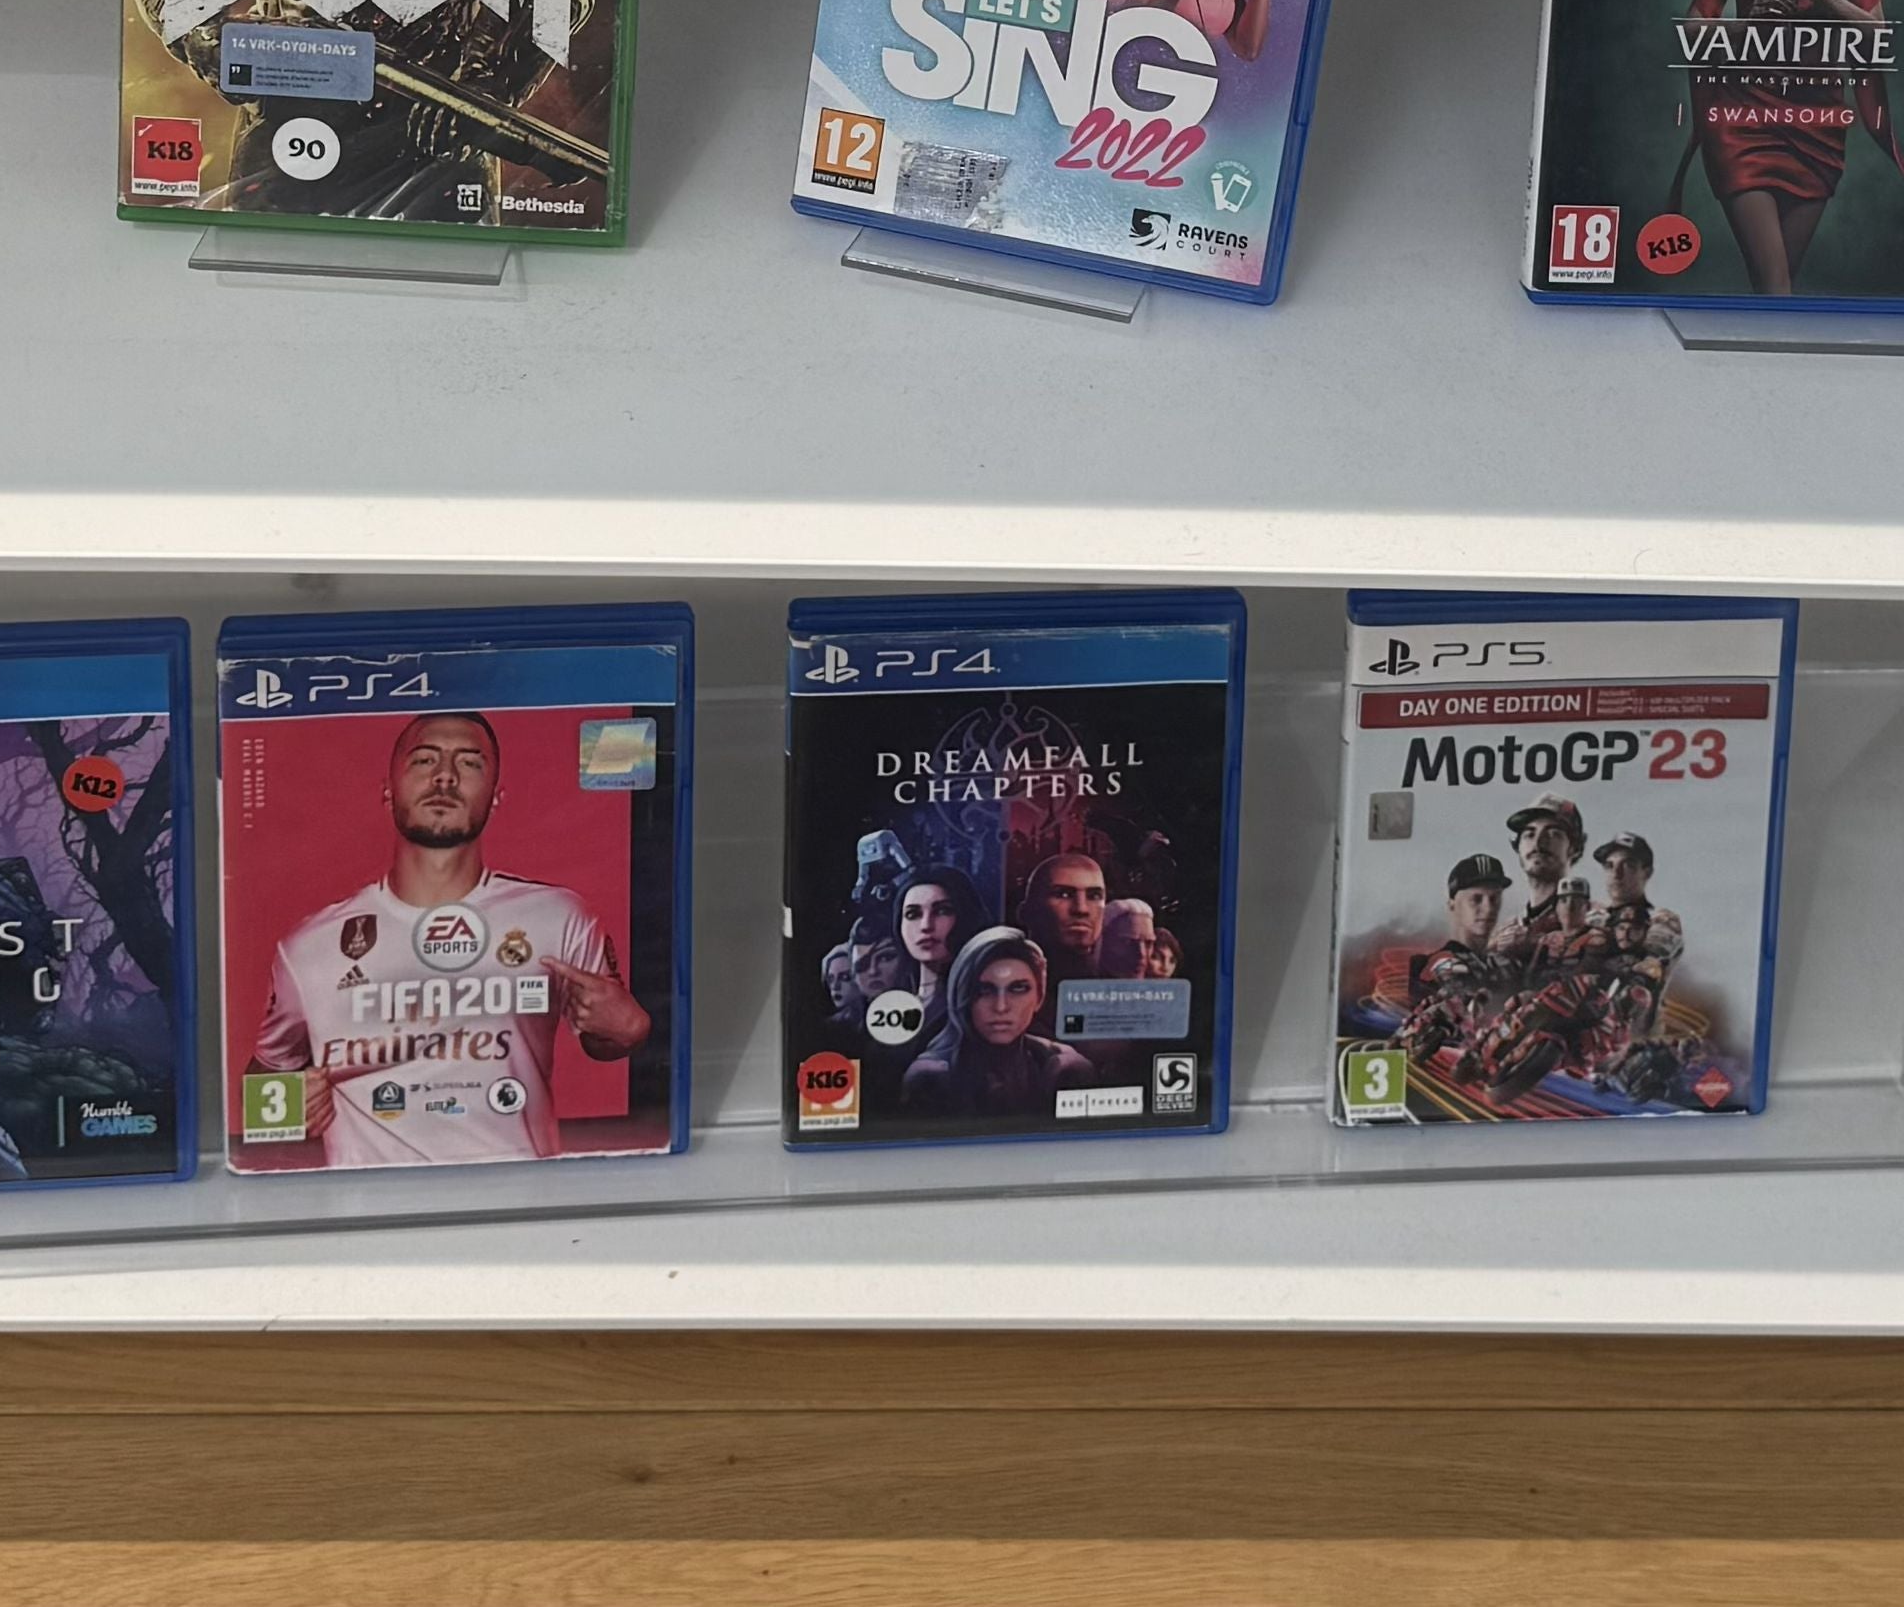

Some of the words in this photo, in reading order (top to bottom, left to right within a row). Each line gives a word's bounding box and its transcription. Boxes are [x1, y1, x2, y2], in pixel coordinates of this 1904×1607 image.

[1675, 24, 1896, 64] VAMPIRE
[1696, 74, 1728, 85] THE
[1740, 75, 1870, 92] MASQUERADE
[1708, 106, 1856, 125] SWANSONG
[147, 141, 194, 161] K18
[288, 138, 326, 160] 90
[824, 118, 876, 171] 12
[1054, 107, 1207, 187] 2022
[501, 196, 585, 215] Bethesda
[1178, 223, 1248, 249] RAVENS
[1558, 213, 1612, 262] 18
[1647, 233, 1693, 259] K18
[1176, 240, 1246, 261] COURT
[876, 648, 996, 678] PS4
[1433, 641, 1547, 667] PS5
[309, 672, 433, 702] PS4
[1400, 699, 1440, 717] DAY
[1445, 697, 1487, 715] ONE
[1493, 694, 1581, 714] EDITION
[876, 741, 1144, 778] DREAMFALL
[1401, 730, 1639, 788] MotoGP
[1649, 728, 1727, 780] 23
[72, 773, 116, 798] K12
[894, 771, 1123, 804] CHAPTERS
[426, 914, 475, 940] EA
[422, 939, 478, 957] SPORTS
[520, 980, 544, 989] FIFA
[322, 1025, 512, 1067] Emirates
[806, 1069, 849, 1090] K16
[1365, 1058, 1390, 1098] 3
[80, 1100, 133, 1118] Humble
[260, 1080, 287, 1123] 3
[1156, 1095, 1194, 1103] DEEP
[81, 1114, 157, 1136] GAMES
